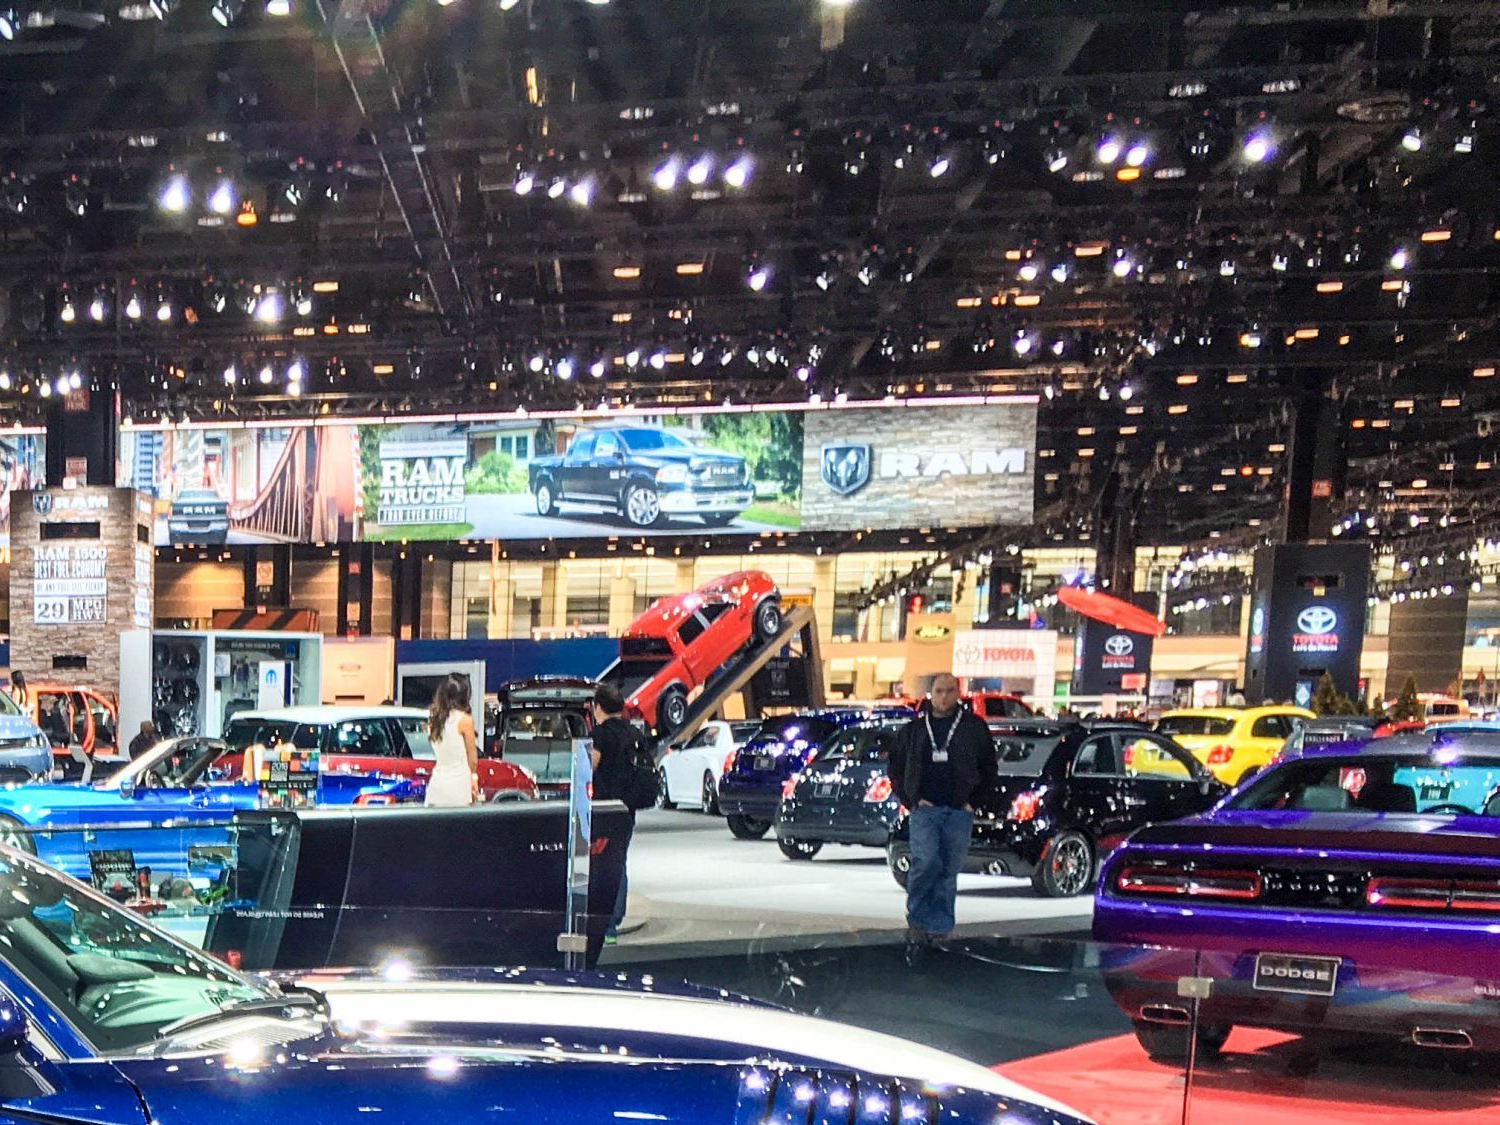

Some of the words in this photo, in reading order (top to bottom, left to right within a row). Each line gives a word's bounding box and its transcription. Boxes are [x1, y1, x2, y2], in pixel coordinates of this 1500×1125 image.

[880, 448, 1026, 478] RAM
[380, 457, 467, 487] RAM
[54, 495, 109, 509] RAM
[380, 486, 465, 505] TRUCKS
[182, 506, 216, 514] RAM
[35, 547, 70, 560] RAM
[75, 546, 108, 560] 1500
[54, 560, 69, 578] FUEL
[73, 560, 106, 578] ECONOMY
[38, 602, 64, 619] 29
[73, 599, 103, 610] MPG
[73, 610, 103, 620] HWY
[1293, 634, 1338, 645] TOYOTA
[983, 647, 1035, 661] TOYOTA
[1261, 965, 1330, 981] DODGE
